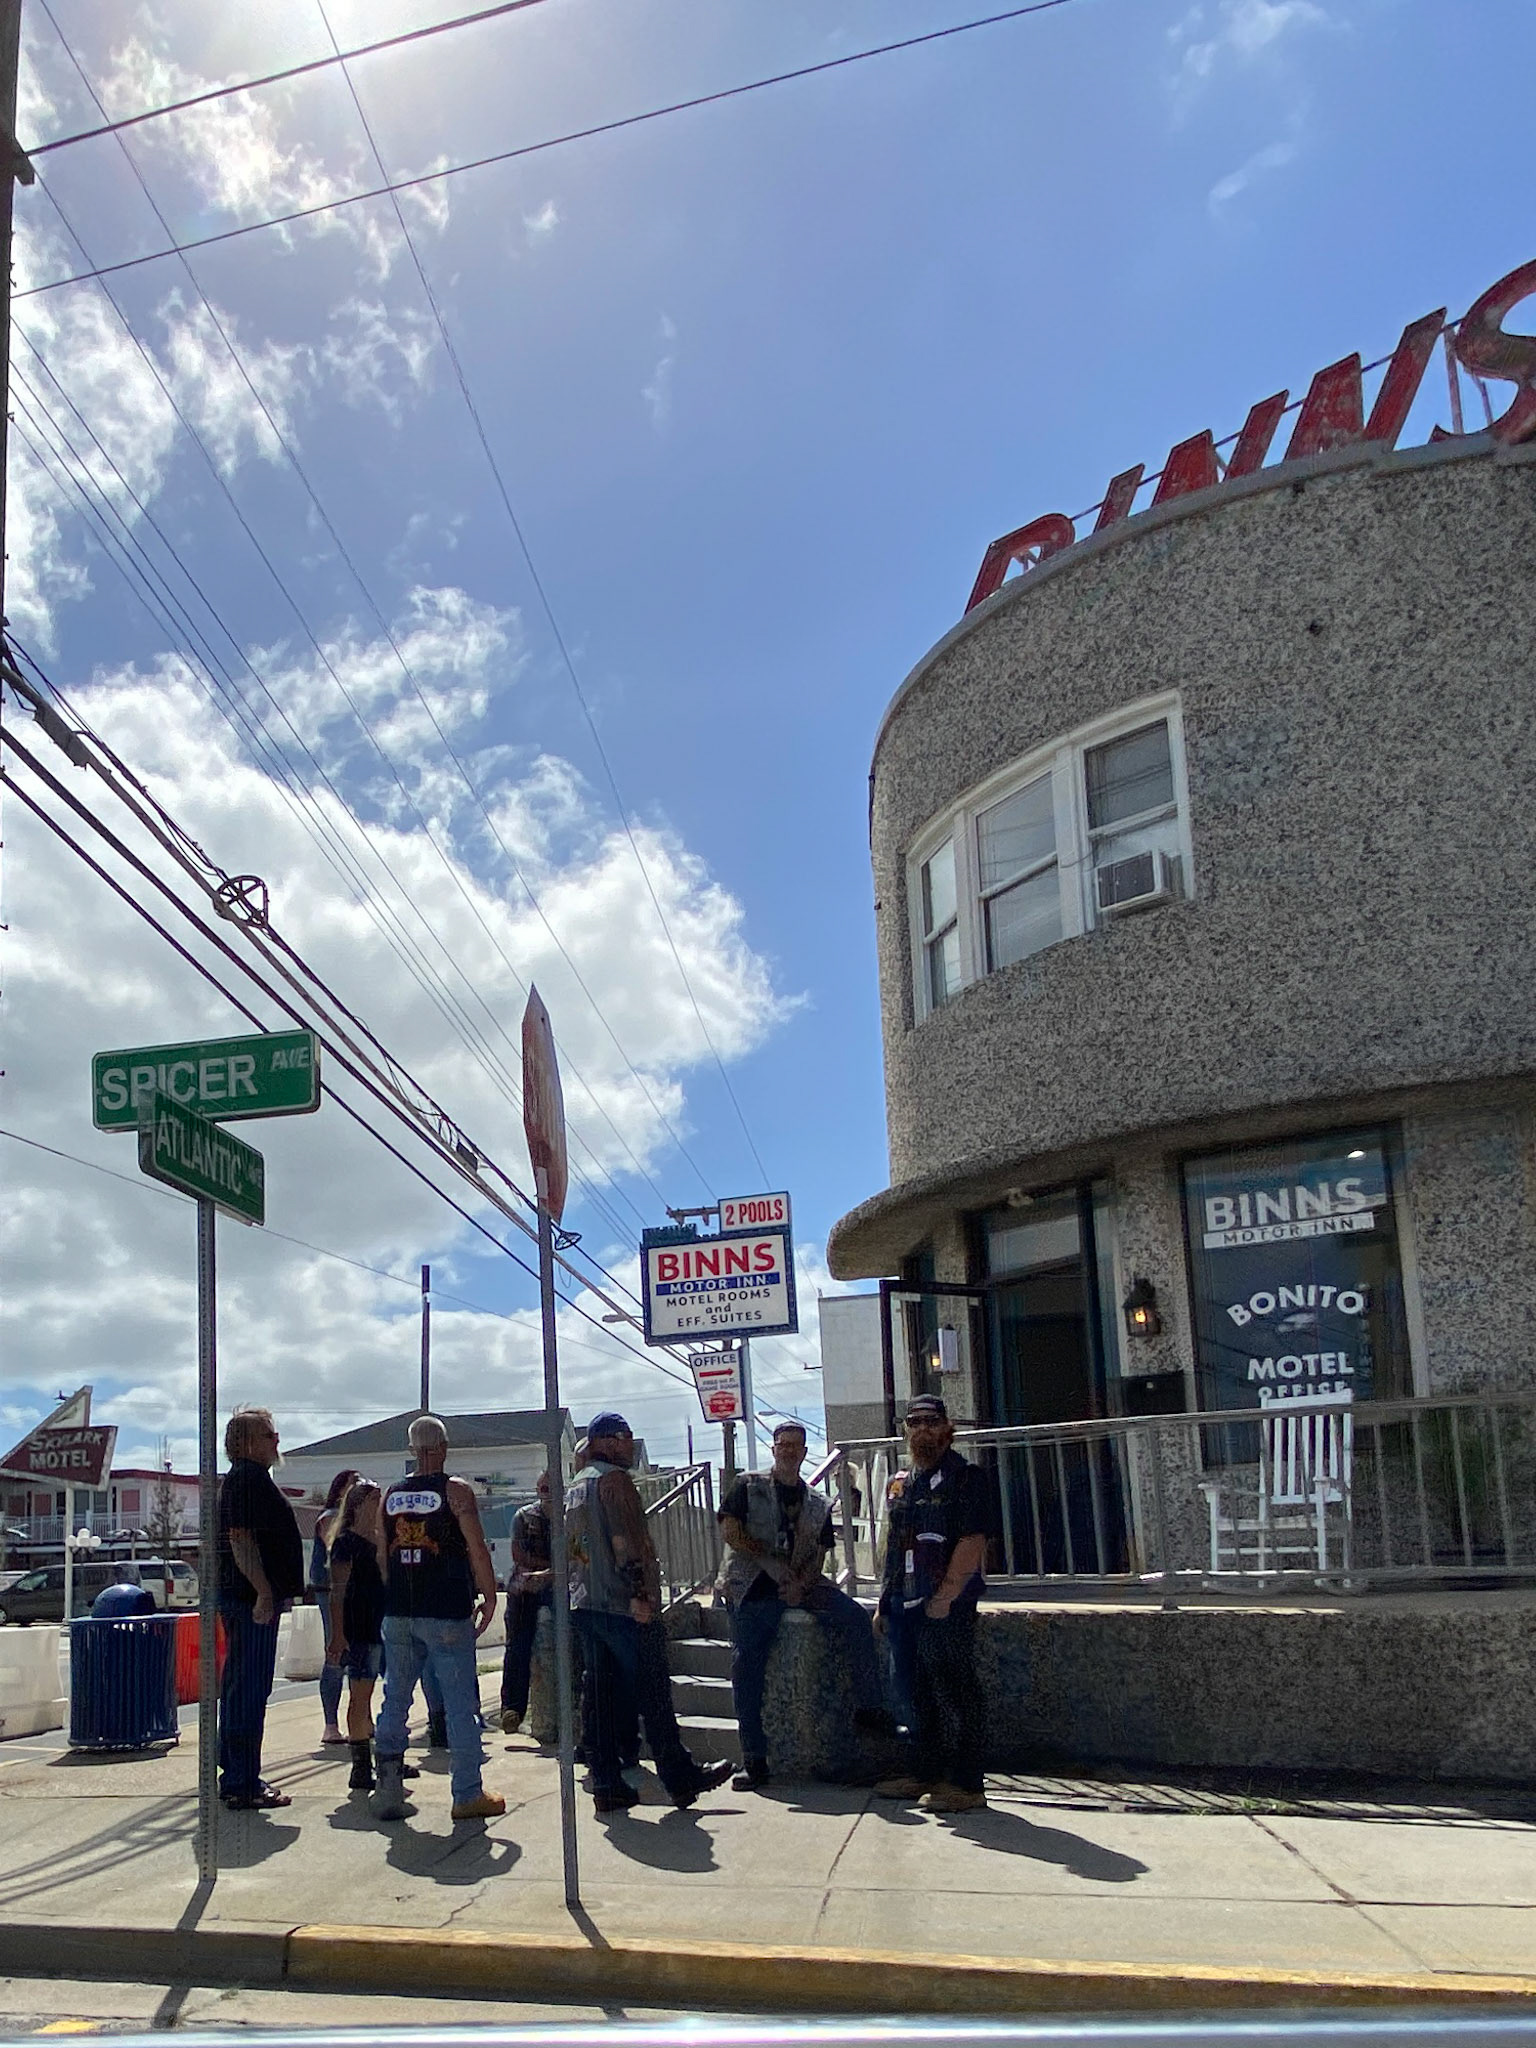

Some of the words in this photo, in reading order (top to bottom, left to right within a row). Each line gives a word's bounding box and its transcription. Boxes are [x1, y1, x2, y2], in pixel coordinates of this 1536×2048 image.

[101, 1054, 259, 1110] SPICER
[270, 1046, 311, 1071] AVE
[157, 1110, 241, 1195] ATLANTIC
[725, 1205, 735, 1225] 2
[739, 1198, 784, 1224] POOLS
[1205, 1177, 1366, 1231] BINNS
[1223, 1224, 1300, 1244] MOTOR
[1313, 1217, 1354, 1234] INN
[658, 1243, 775, 1281] BINNS
[667, 1294, 714, 1307] MOTEL
[718, 1288, 771, 1302] ROOMS
[669, 1279, 728, 1294] MOTOR
[736, 1275, 767, 1288] INN
[677, 1317, 706, 1327] EFF.
[710, 1310, 762, 1324] SUITES
[705, 1303, 731, 1314] and
[1227, 1284, 1364, 1326] BONITO
[694, 1354, 737, 1367] OFFICE
[1247, 1352, 1355, 1380] MOTEL
[29, 1449, 92, 1470] MOTEL
